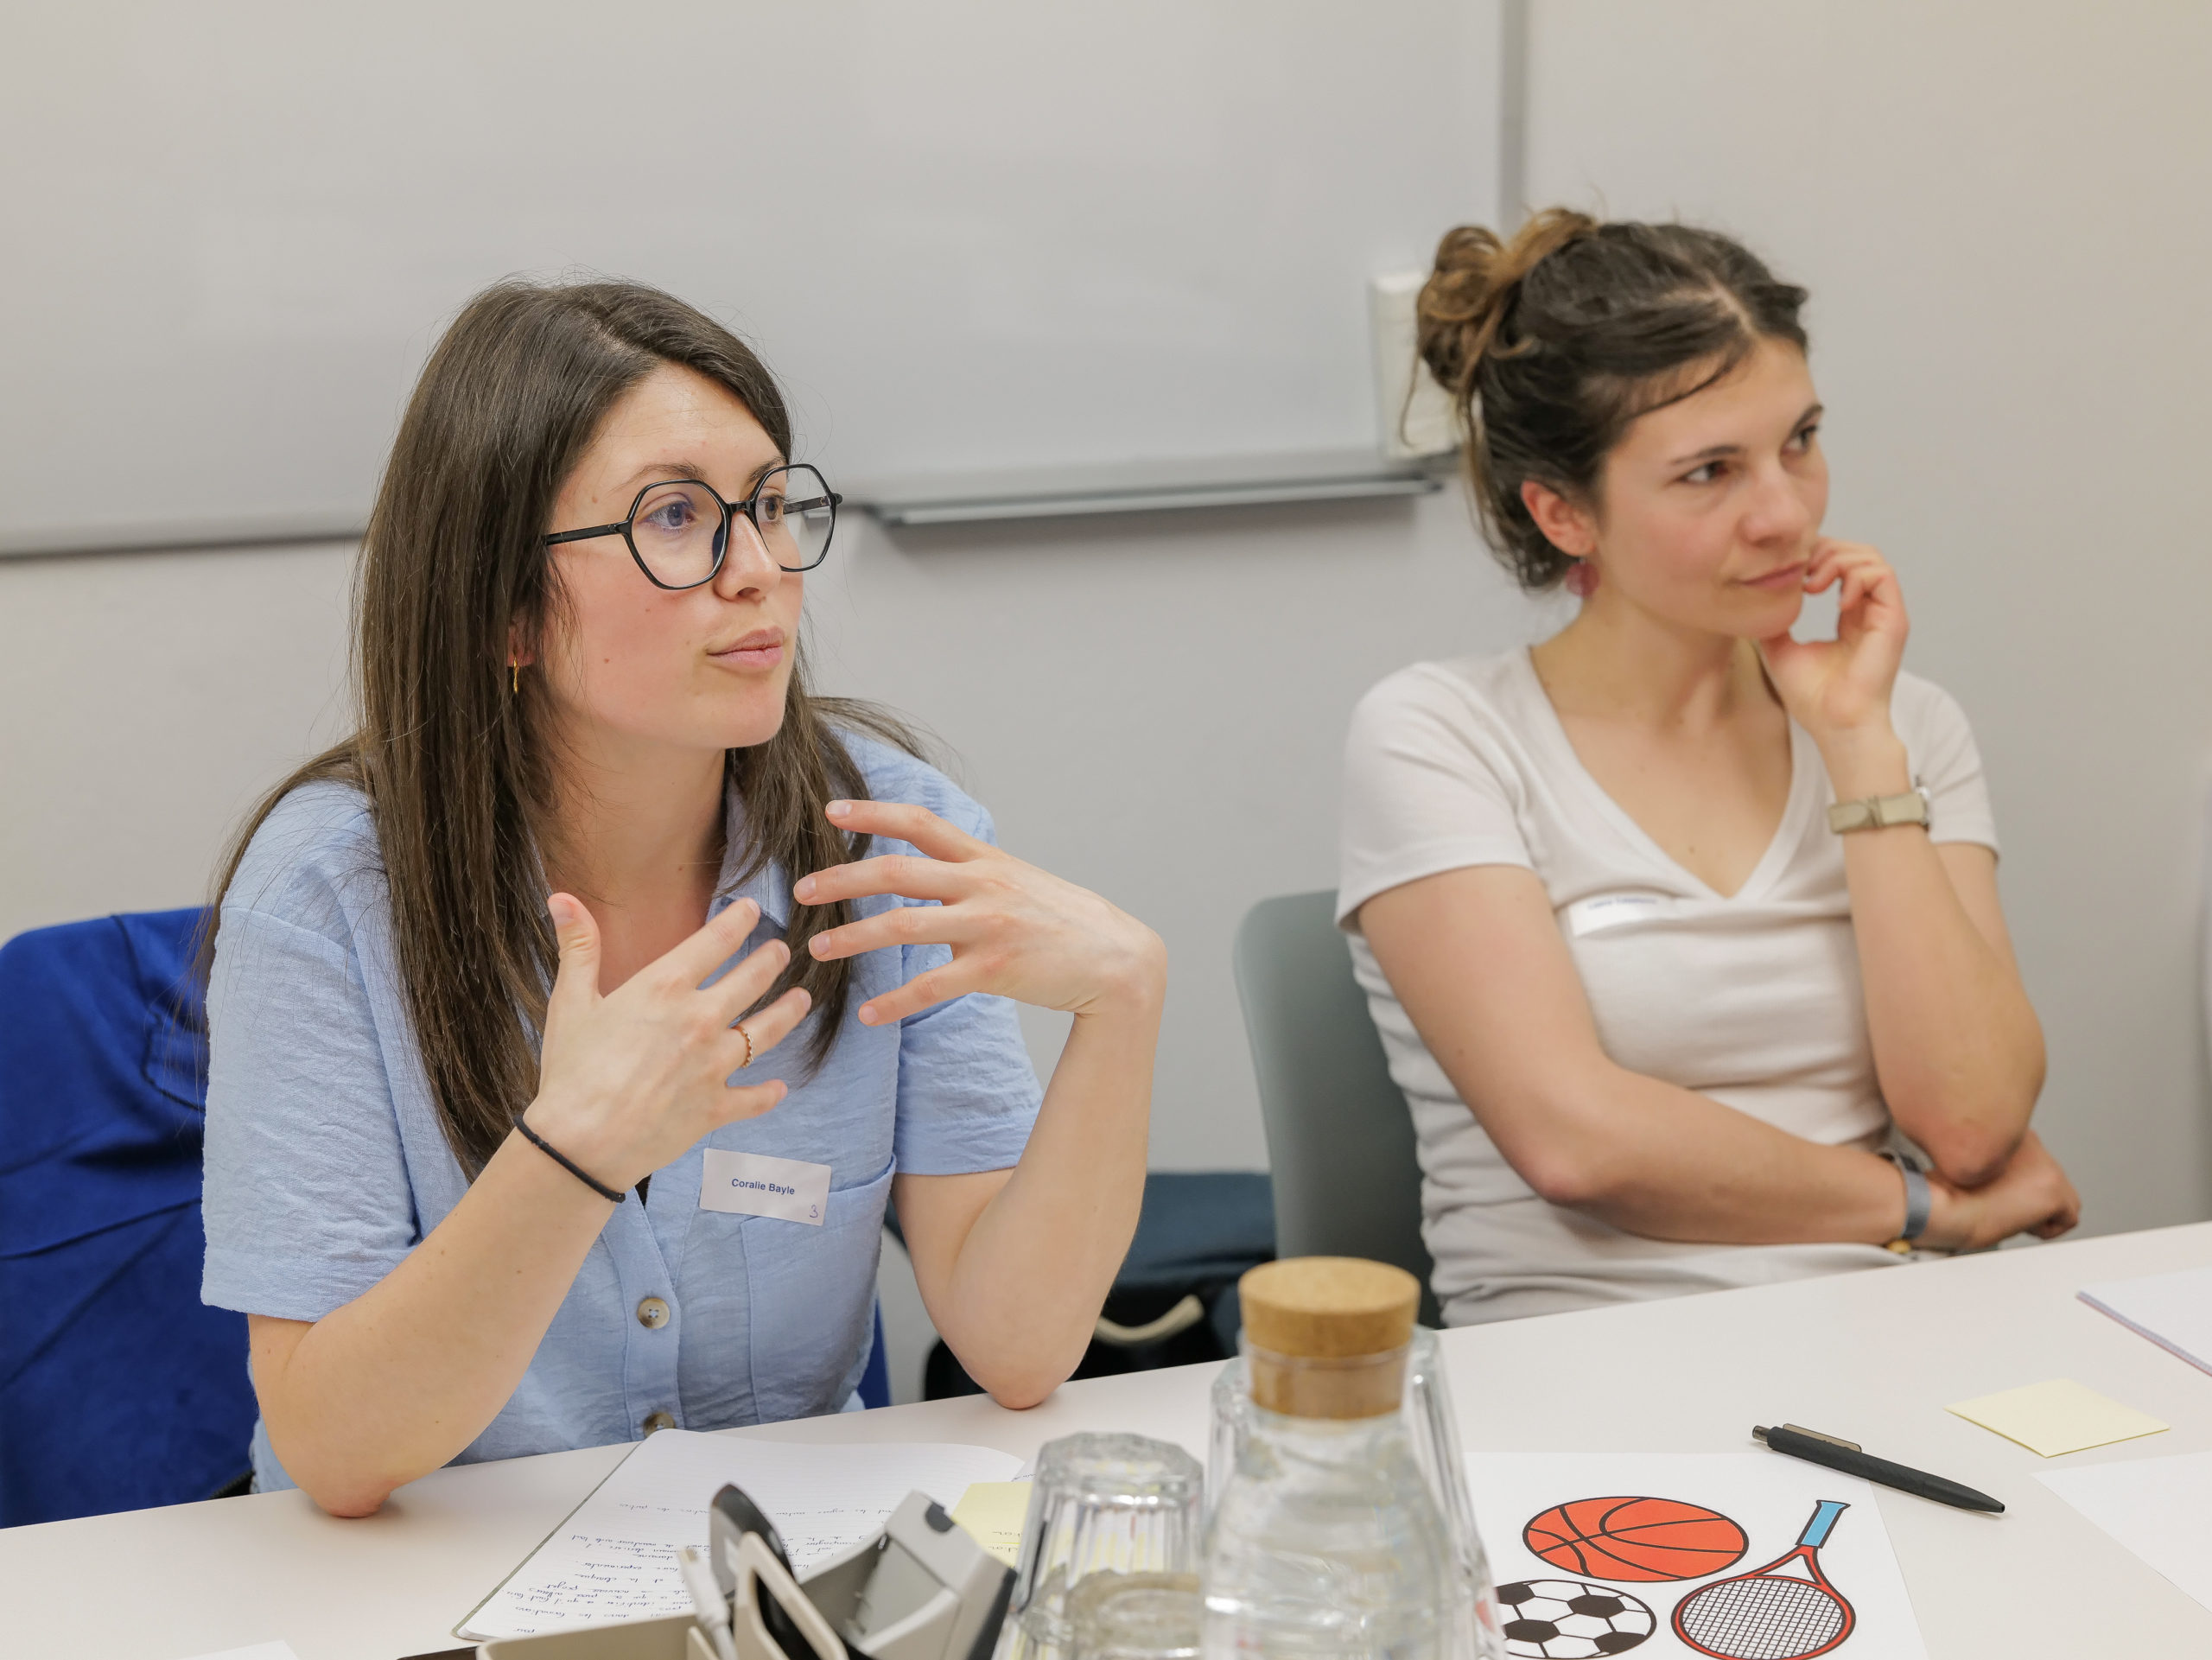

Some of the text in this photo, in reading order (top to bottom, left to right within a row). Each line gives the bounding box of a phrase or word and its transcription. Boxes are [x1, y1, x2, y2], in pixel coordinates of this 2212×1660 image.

[731, 1178, 796, 1195] Coralie Bayle
[809, 1204, 818, 1218] 3
